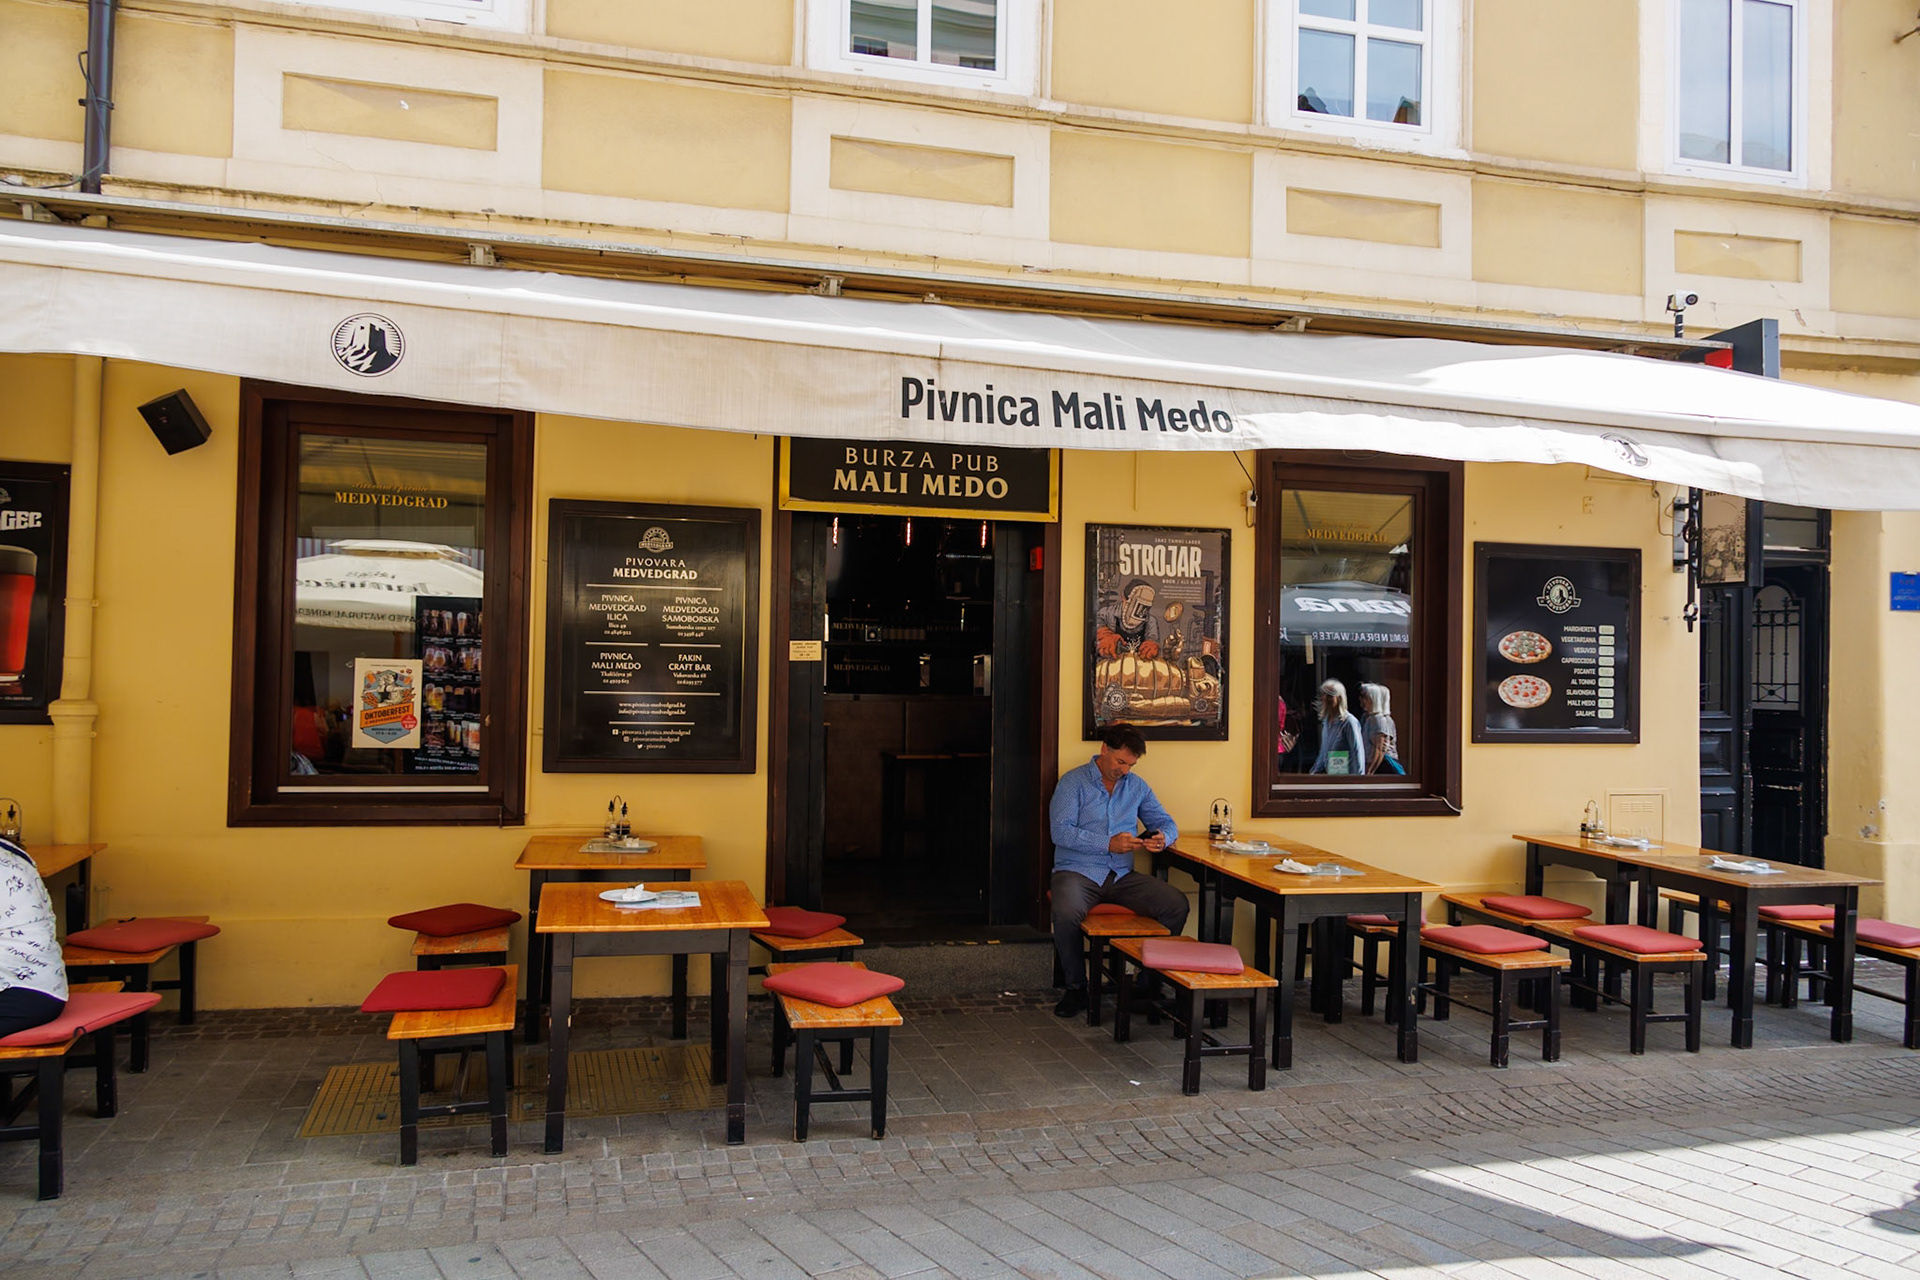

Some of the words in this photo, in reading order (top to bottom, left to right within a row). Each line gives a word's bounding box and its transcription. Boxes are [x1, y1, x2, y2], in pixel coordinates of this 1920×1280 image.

[901, 377, 1039, 427] Pivnica
[1051, 390, 1127, 431] Mali
[1135, 397, 1234, 434] Medo
[845, 447, 935, 469] BURZA
[951, 453, 999, 472] PUB
[833, 468, 909, 494] MALI
[921, 473, 1009, 499] MEDO
[334, 491, 448, 509] MEDVEDGRAD
[1307, 528, 1387, 543] MEDVEDGRAD
[625, 557, 686, 568] PIVOVARA
[1118, 543, 1202, 578] STROJAR
[612, 567, 698, 580] MEDVEDGRAD
[601, 594, 634, 603] PIVNICA
[675, 596, 707, 605] PIVNICA
[589, 603, 647, 612] MEDVEDGRAD
[662, 605, 719, 614] MEDVEDGRAD
[607, 613, 628, 621] ILICA
[661, 615, 720, 623] SAMOBORSKA
[600, 652, 633, 660] PIVNICA
[678, 654, 702, 662] FAKIN
[591, 661, 614, 670] MALI
[615, 662, 641, 670] MEDO
[668, 663, 693, 671] CRAFT
[694, 664, 712, 672] BAR
[364, 705, 411, 721] OKTOBERFEST
